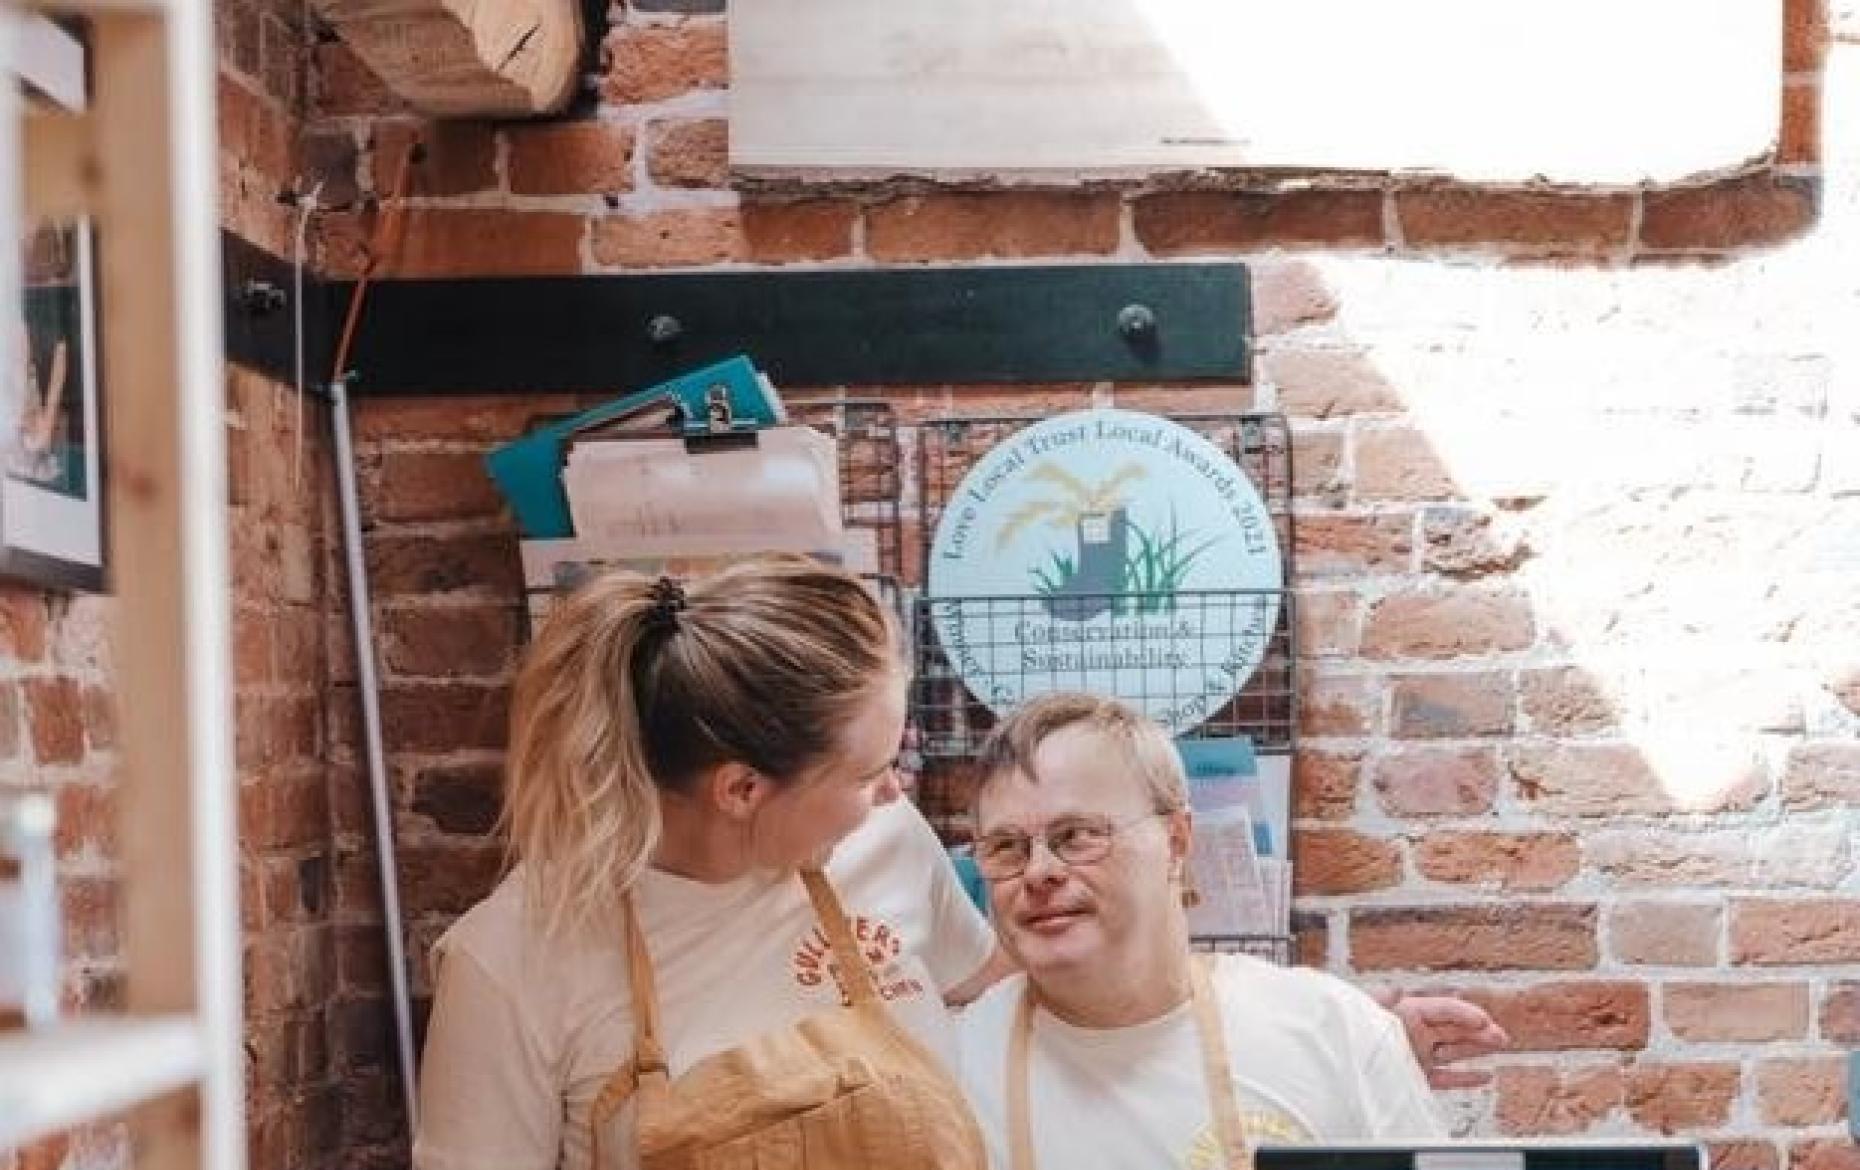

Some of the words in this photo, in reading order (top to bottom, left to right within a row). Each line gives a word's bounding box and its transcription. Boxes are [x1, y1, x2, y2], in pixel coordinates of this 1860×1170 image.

[942, 506, 977, 559] Love
[967, 448, 1025, 502] Local
[1025, 424, 1087, 454] Trust
[1095, 420, 1162, 446] Local
[1162, 436, 1236, 499] Awards
[1232, 502, 1267, 554] 2021
[1014, 621, 1168, 641] Conservation
[1172, 620, 1190, 638] &
[1022, 648, 1185, 673] Sustainability
